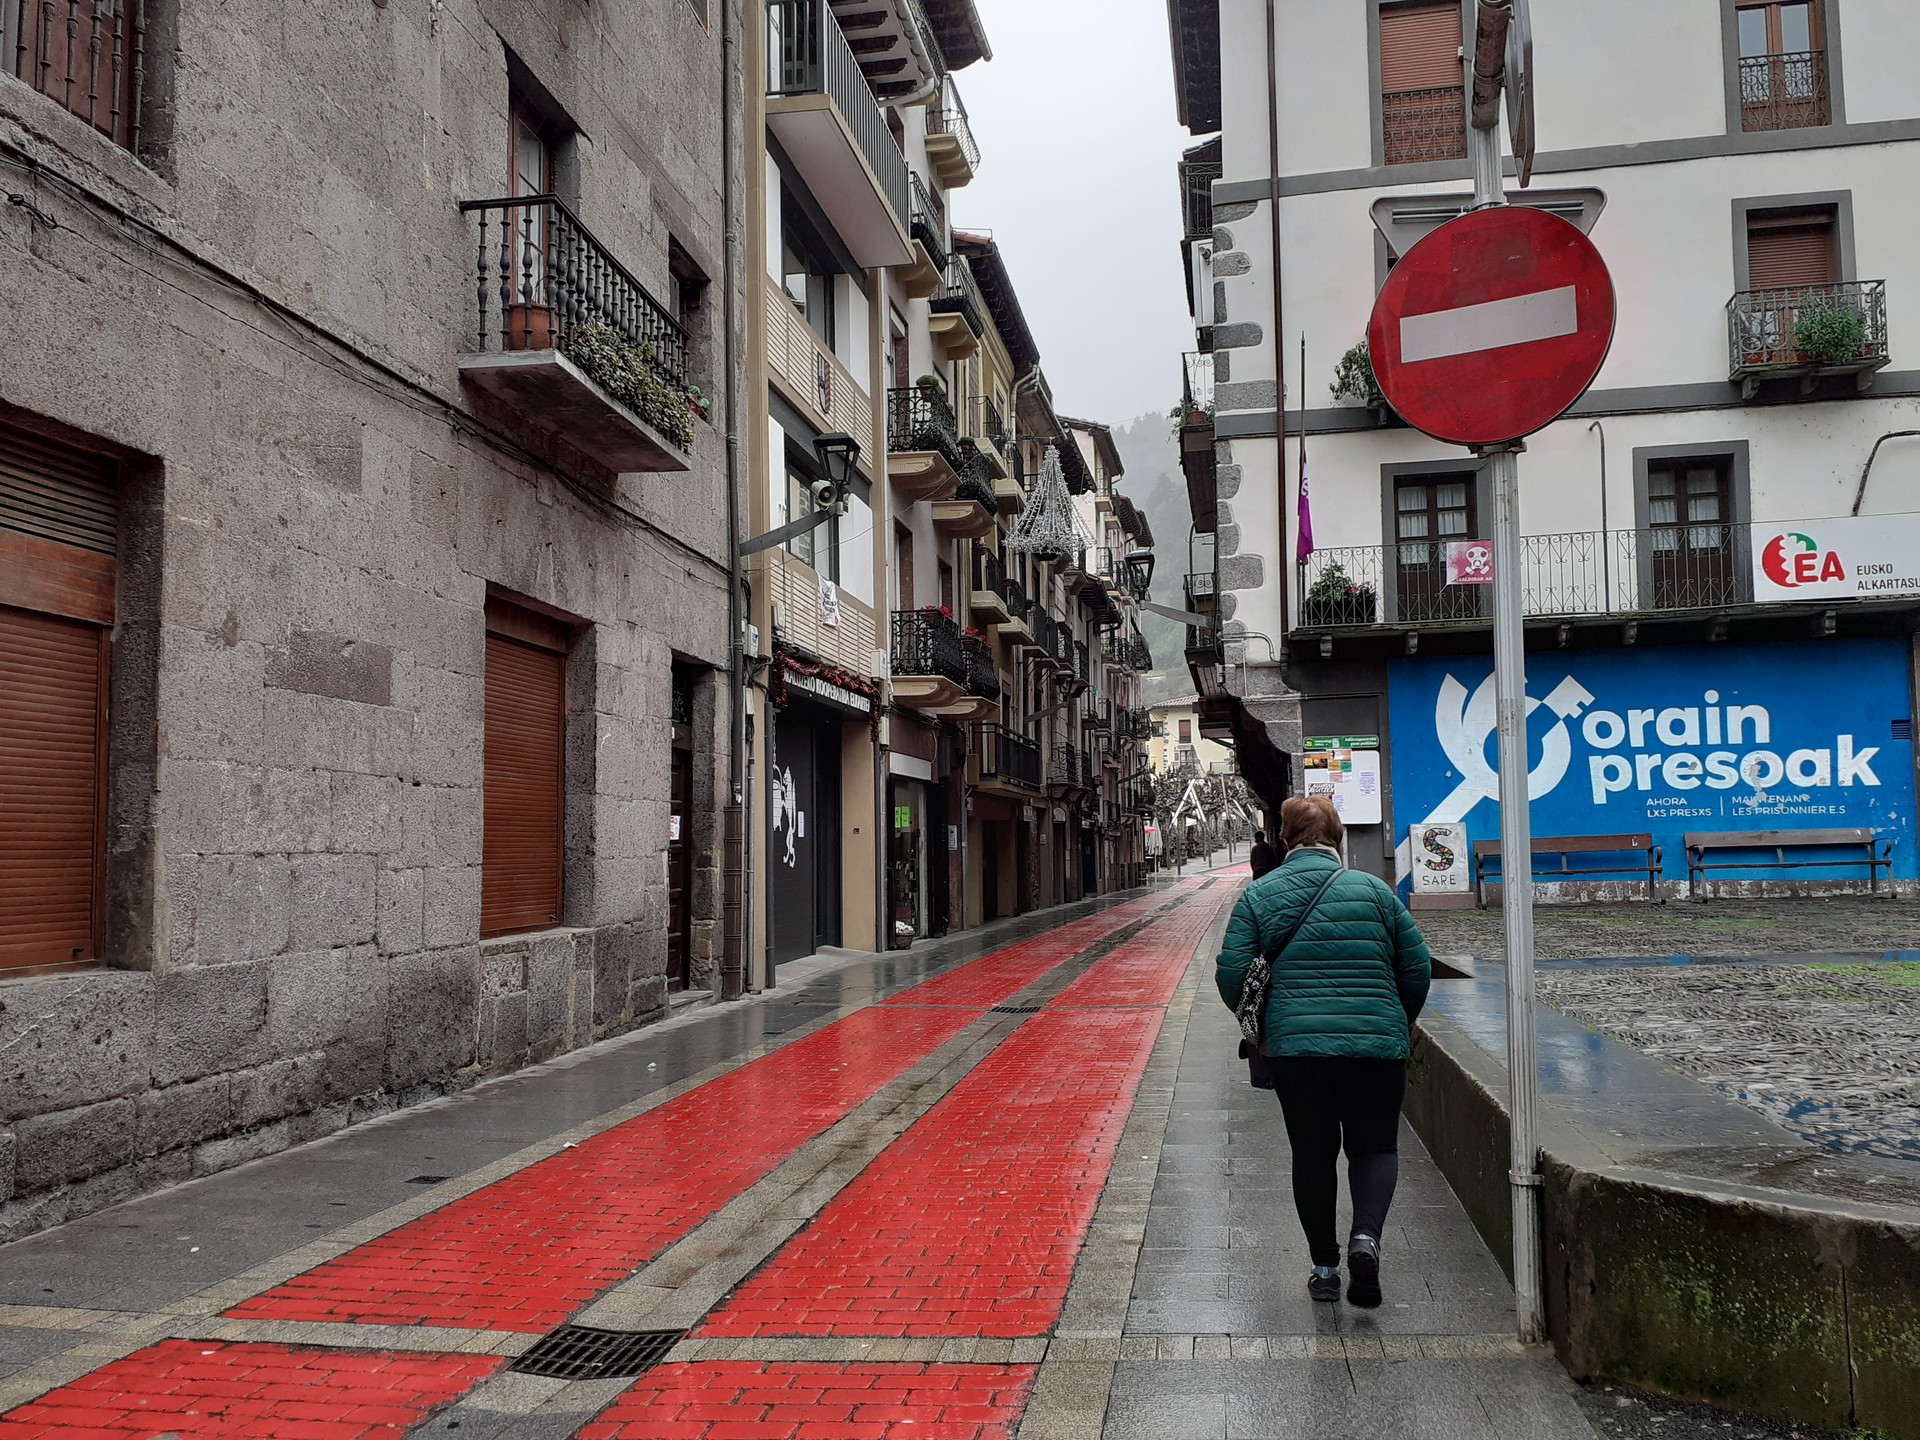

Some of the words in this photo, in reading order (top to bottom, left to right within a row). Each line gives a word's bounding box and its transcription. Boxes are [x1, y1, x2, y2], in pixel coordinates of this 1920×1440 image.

[1794, 551, 1846, 583] EA
[1857, 564, 1893, 575] EUSKO
[1582, 690, 1770, 749] orain
[1589, 734, 1881, 804] presoak
[1646, 797, 1688, 806] AHORA
[1647, 808, 1666, 818] LXS
[1669, 808, 1712, 817] PRESXS
[1732, 808, 1752, 816] LES
[1755, 805, 1846, 815] PRISONNIER.E.S
[1422, 875, 1457, 886] SARE
